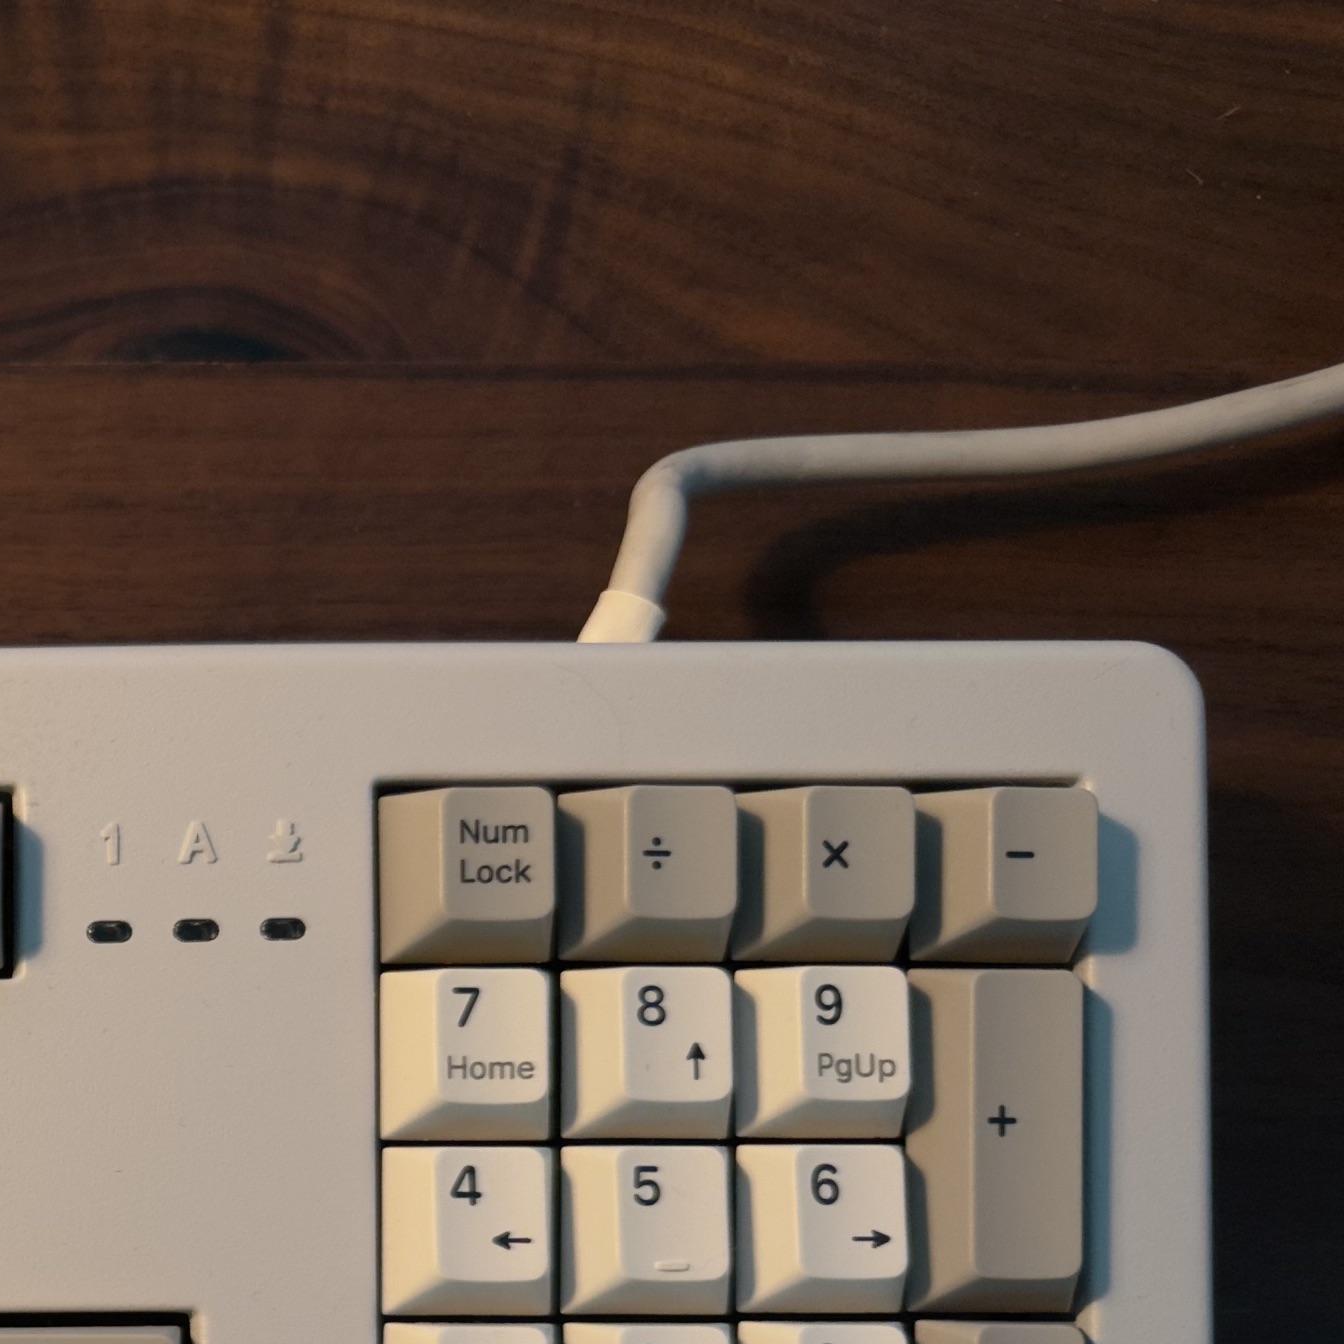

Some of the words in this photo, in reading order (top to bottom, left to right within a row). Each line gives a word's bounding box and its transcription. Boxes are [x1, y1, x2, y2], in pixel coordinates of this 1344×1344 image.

[178, 821, 219, 865] A
[460, 819, 529, 844] Num
[460, 859, 531, 884] Lock
[453, 987, 480, 1027] 7
[637, 985, 667, 1026] 8
[815, 984, 843, 1025] 9
[447, 1056, 536, 1080] Home
[818, 1052, 897, 1084] PgUp
[451, 1165, 482, 1206] 4
[634, 1166, 661, 1206] 5
[811, 1163, 840, 1205] 6
